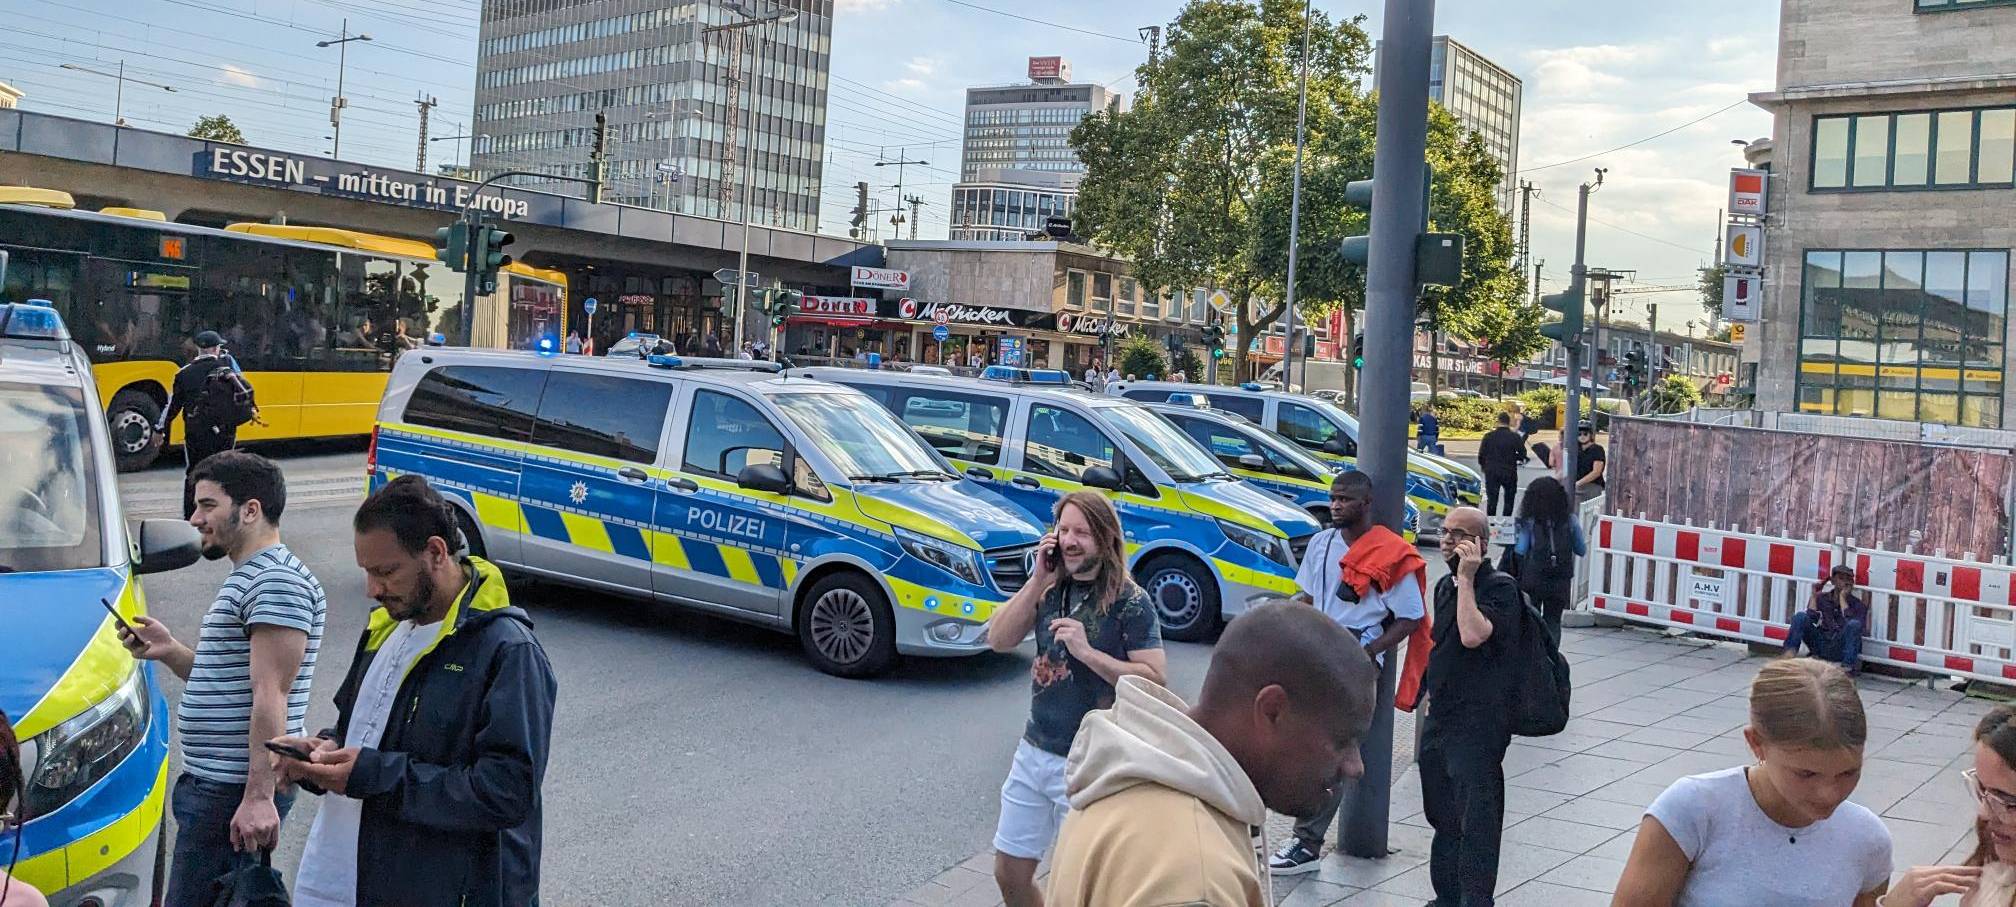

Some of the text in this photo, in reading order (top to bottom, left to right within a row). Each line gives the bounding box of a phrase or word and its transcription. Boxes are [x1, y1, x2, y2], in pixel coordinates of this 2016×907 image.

[213, 148, 305, 184] ESSEN
[338, 171, 417, 200] mitten
[426, 181, 446, 205] in
[455, 185, 528, 219] Europa
[1413, 354, 1454, 371] KASMIR
[687, 506, 766, 540] POLIZEI
[1694, 582, 1720, 593] A.H.V
